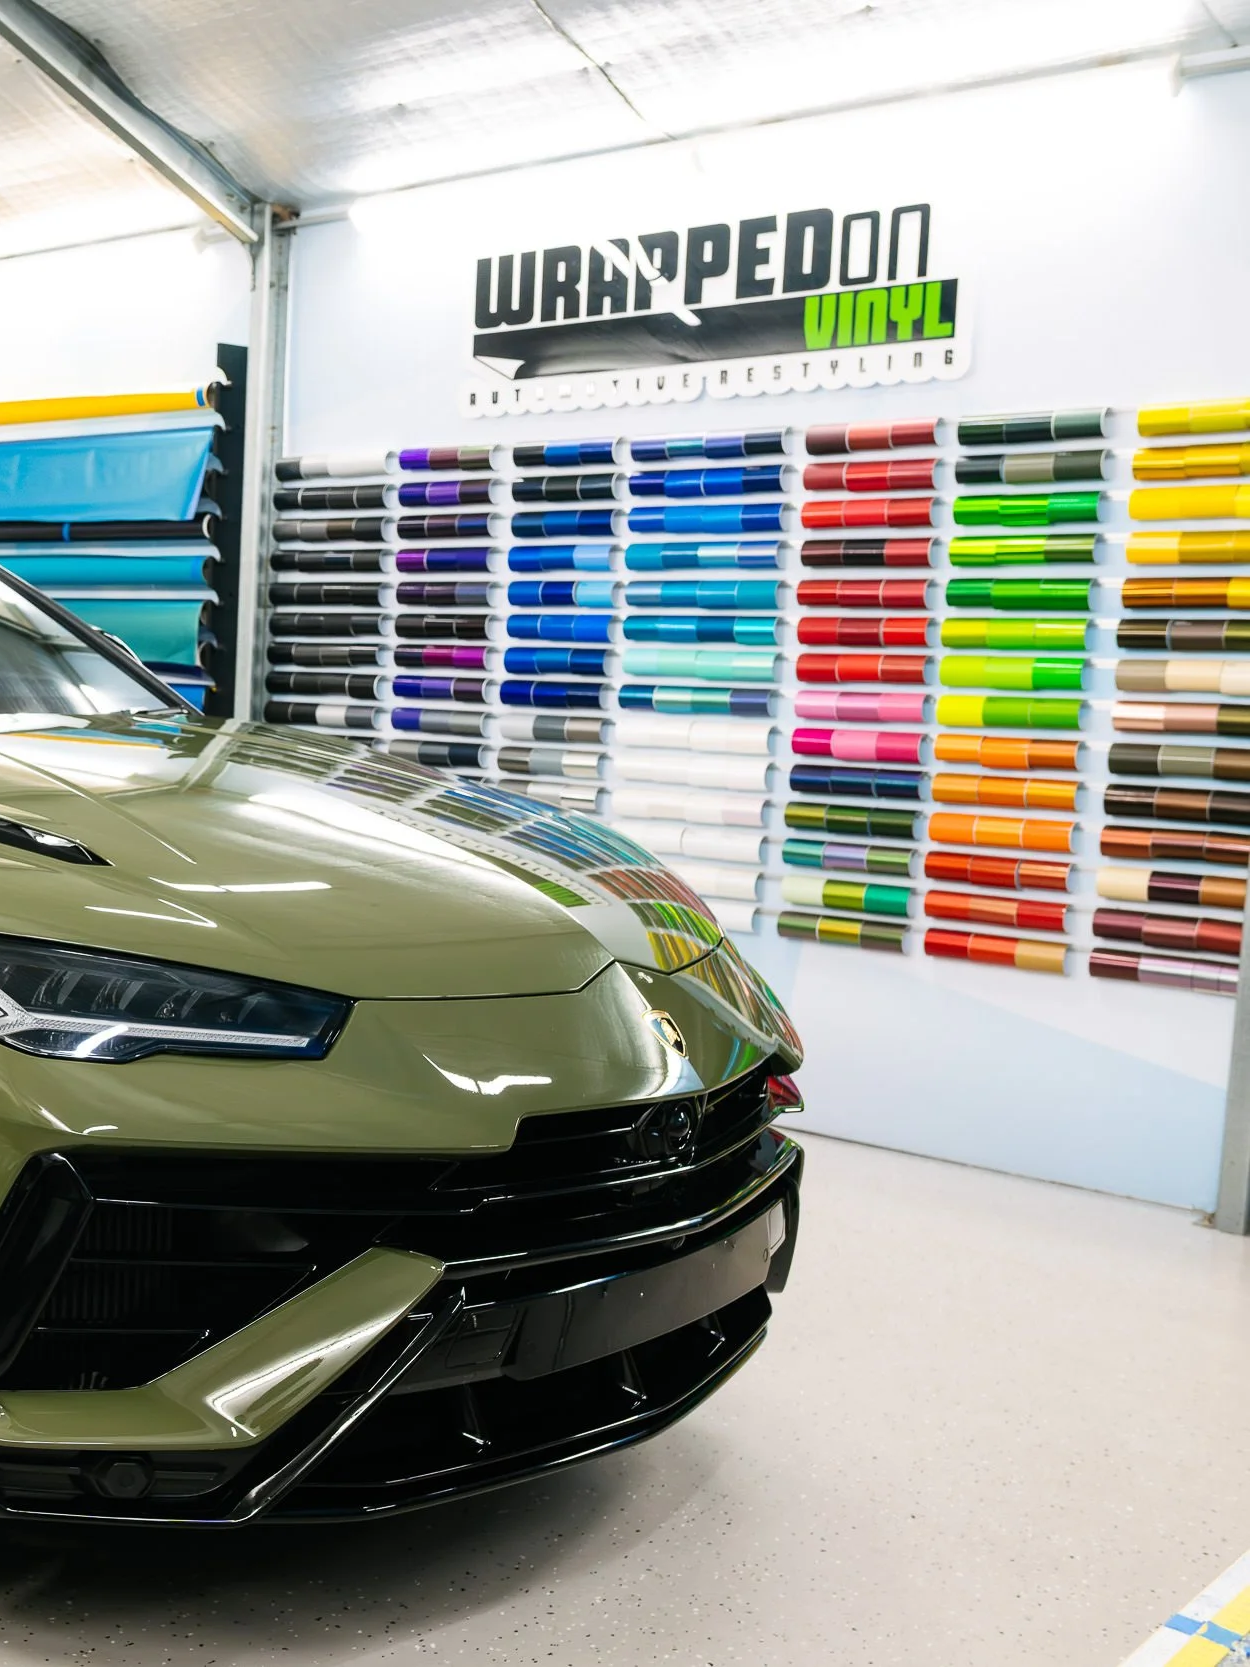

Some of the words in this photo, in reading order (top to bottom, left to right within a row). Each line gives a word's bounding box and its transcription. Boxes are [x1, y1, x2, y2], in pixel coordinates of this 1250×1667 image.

[474, 208, 834, 329] WRAPPED
[803, 282, 954, 350] VINYL
[470, 373, 690, 406] AUTTIVE
[720, 350, 953, 385] RESTYLING
